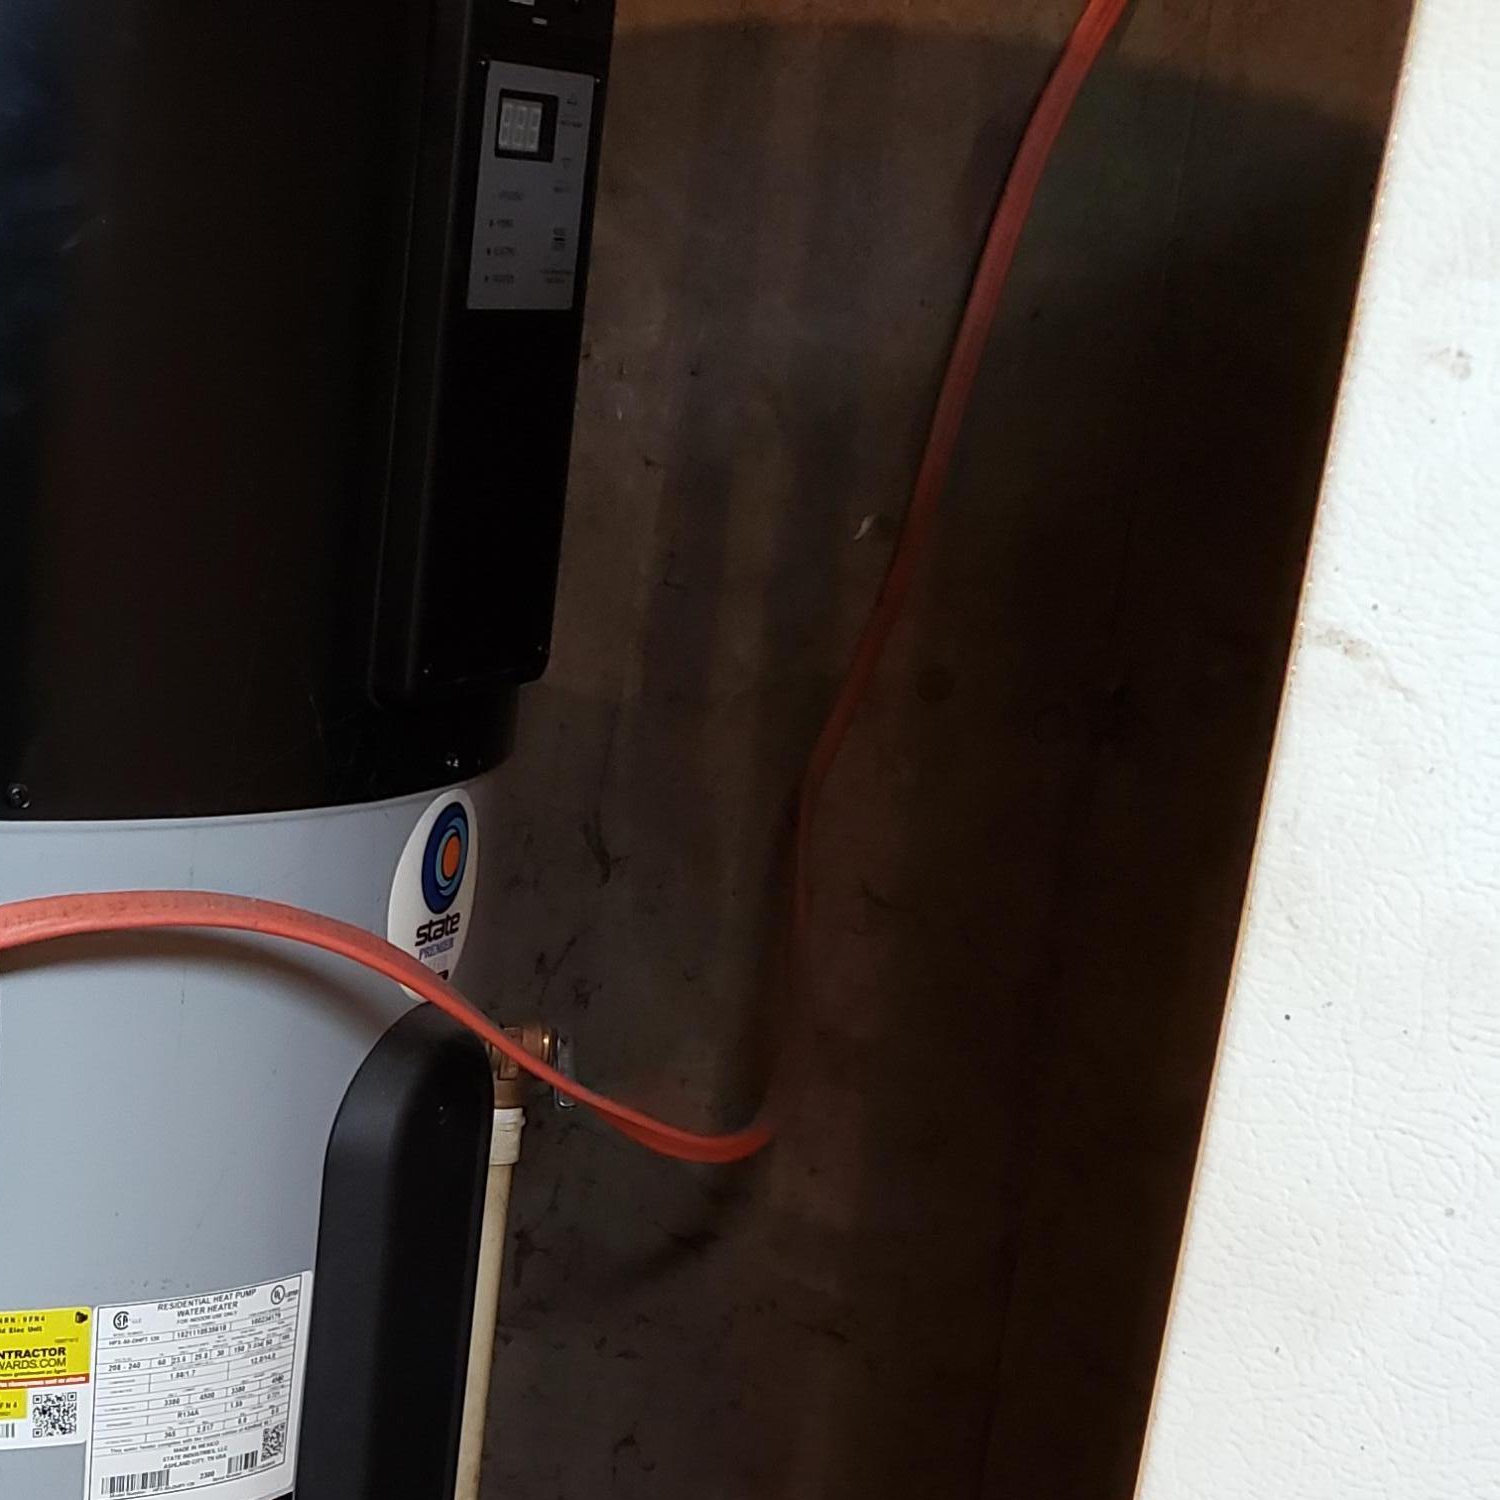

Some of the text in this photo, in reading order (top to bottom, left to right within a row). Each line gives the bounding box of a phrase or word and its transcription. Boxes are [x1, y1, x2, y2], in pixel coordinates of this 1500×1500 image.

[415, 912, 460, 947] state
[157, 1289, 256, 1311] RESIDENTIAL HEAT PUMP
[177, 1302, 238, 1317] WATER HEATER
